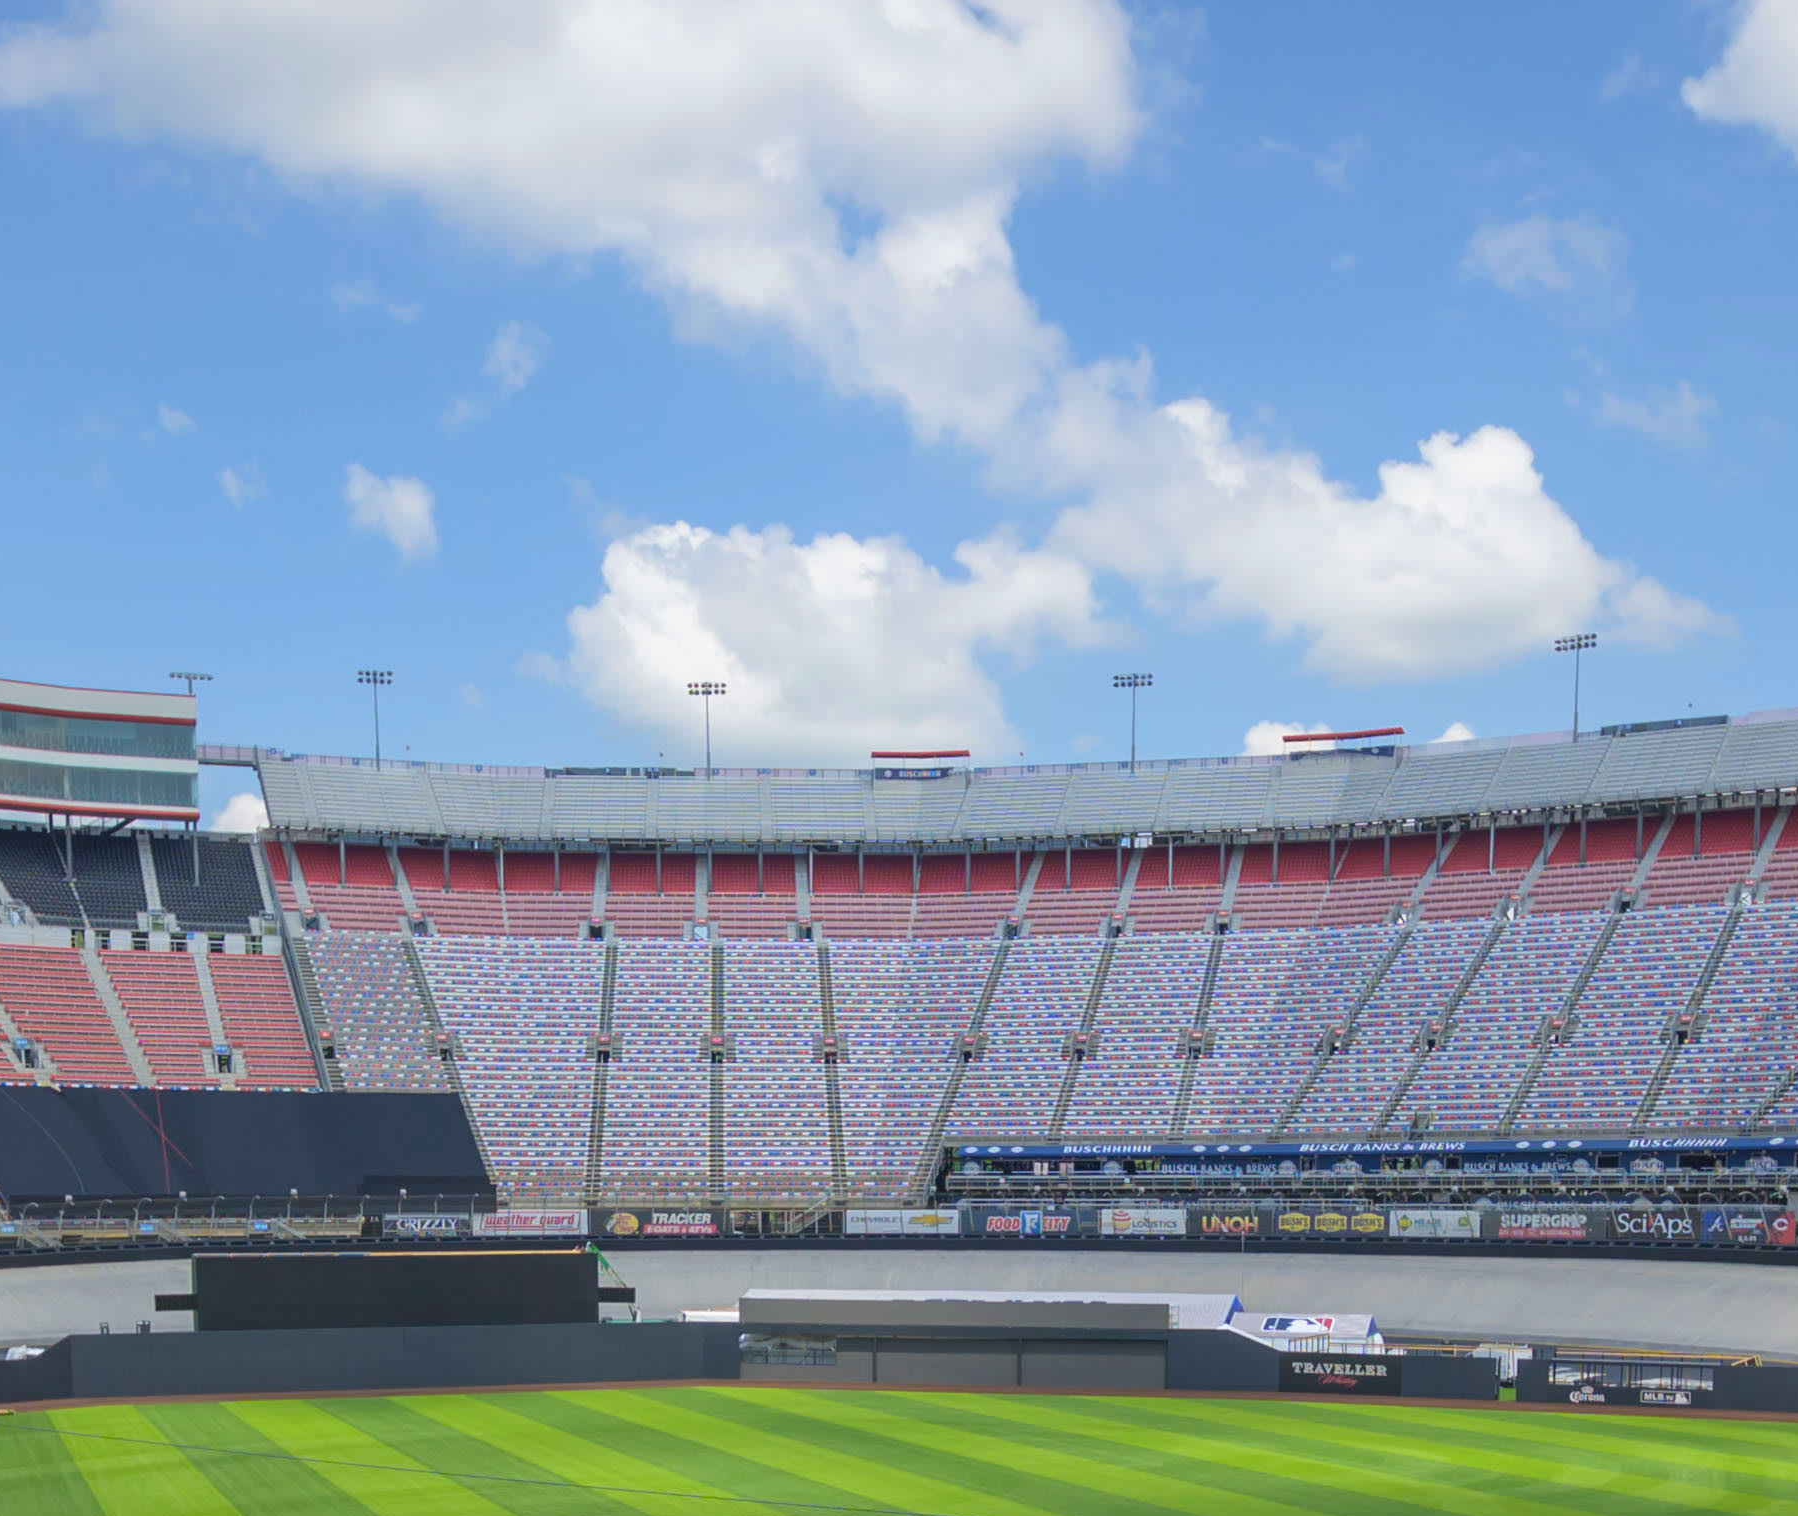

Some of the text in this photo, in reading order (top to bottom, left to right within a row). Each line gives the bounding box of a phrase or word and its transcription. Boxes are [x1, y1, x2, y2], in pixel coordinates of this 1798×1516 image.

[1299, 1143, 1351, 1152] BUSCH
[1353, 1143, 1400, 1152] BANKS
[1418, 1142, 1467, 1151] BREWS
[1161, 1164, 1197, 1174] BUSCH
[1463, 1162, 1495, 1172] BUSCH
[397, 1218, 460, 1231] GRIZZLY
[485, 1213, 575, 1227] weather guard
[652, 1212, 711, 1224] TRACKER
[987, 1215, 1071, 1231] FOOD CITY
[1202, 1216, 1259, 1233] UNOH
[1292, 1362, 1388, 1377] TRAVELLER
